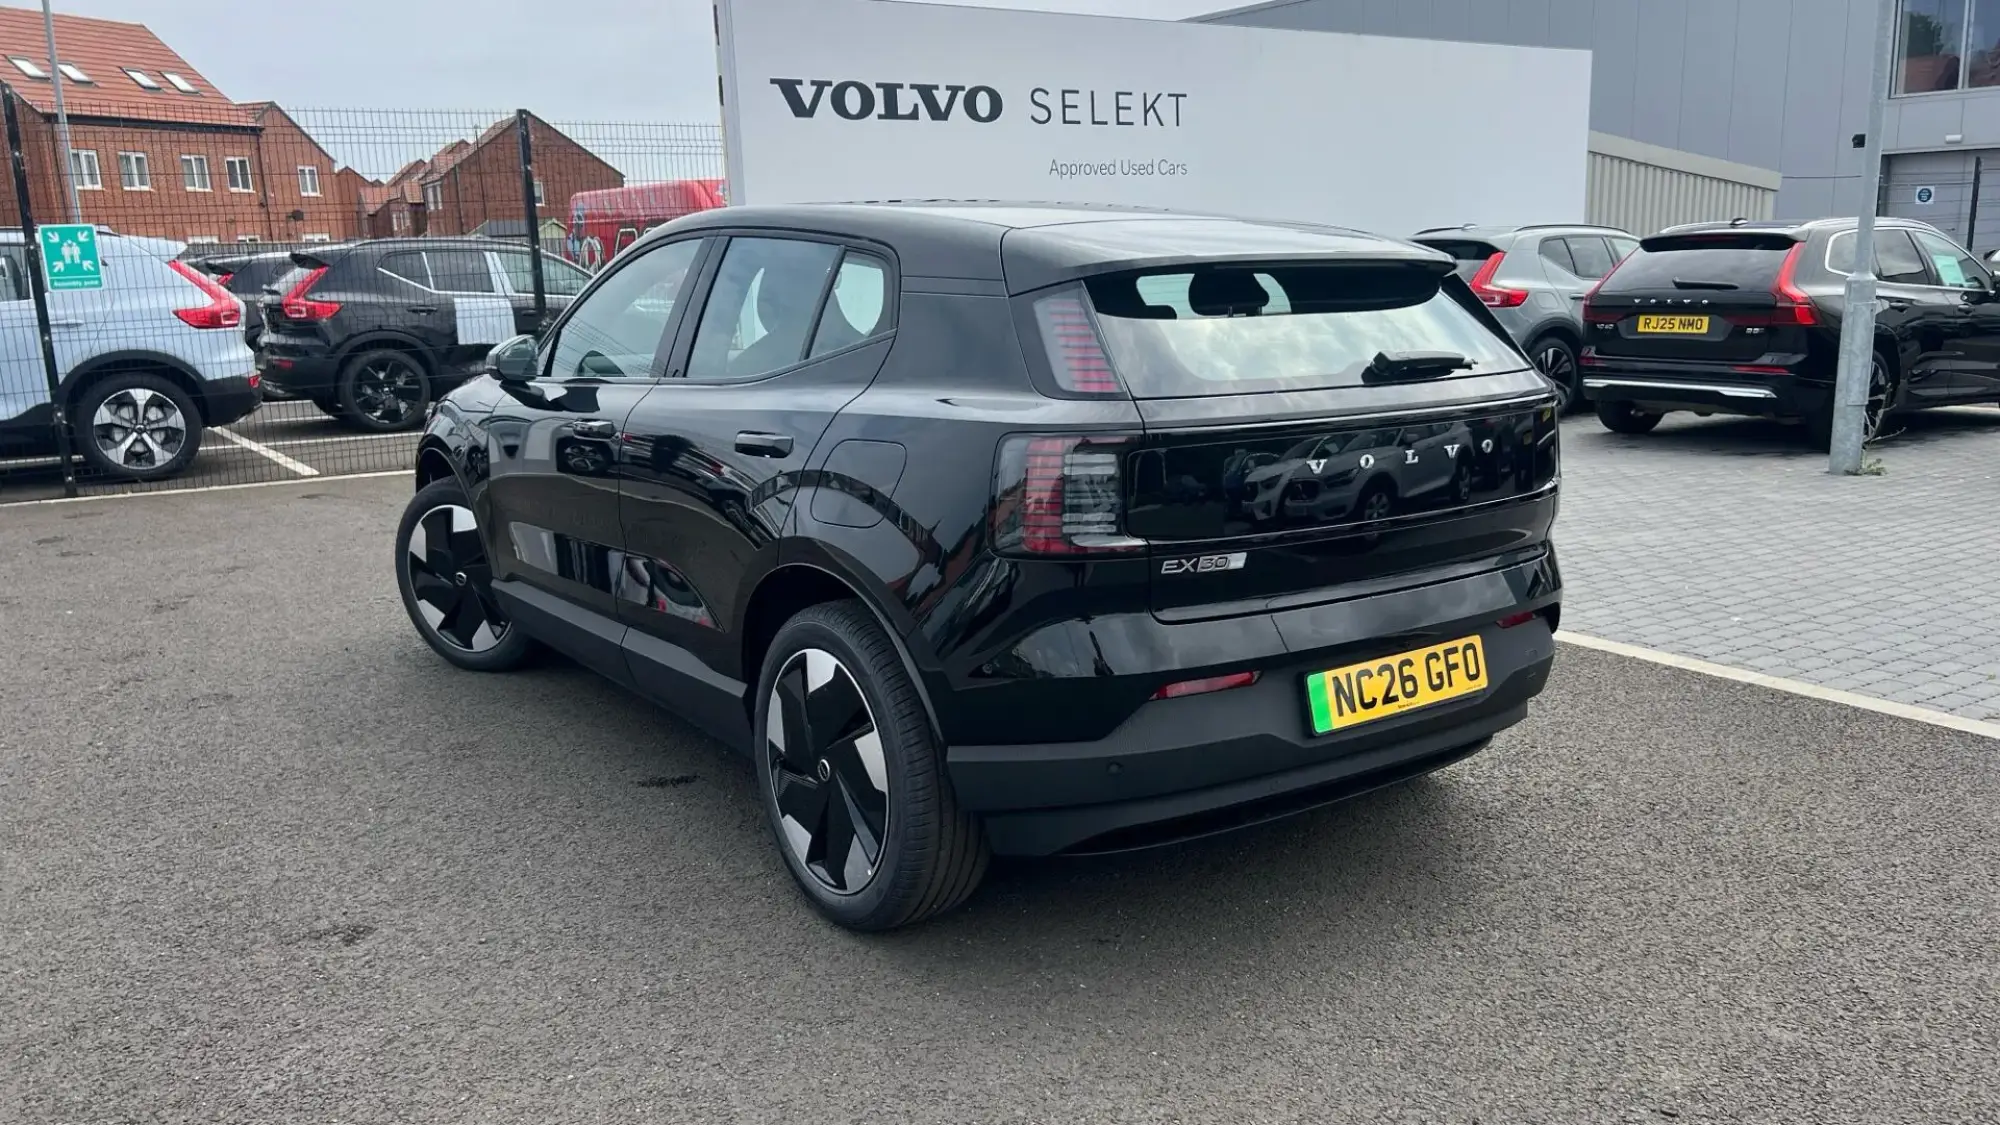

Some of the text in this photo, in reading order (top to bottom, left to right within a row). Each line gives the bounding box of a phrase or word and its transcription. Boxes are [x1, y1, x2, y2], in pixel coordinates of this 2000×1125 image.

[769, 77, 1188, 127] VOLVO SELEKT
[1049, 158, 1188, 180] Approved Used Cars
[1643, 318, 1703, 330] RJ25 NMO
[1306, 438, 1494, 475] VOLVO
[1161, 554, 1230, 574] EX30
[1331, 642, 1481, 718] NC26 GFO
